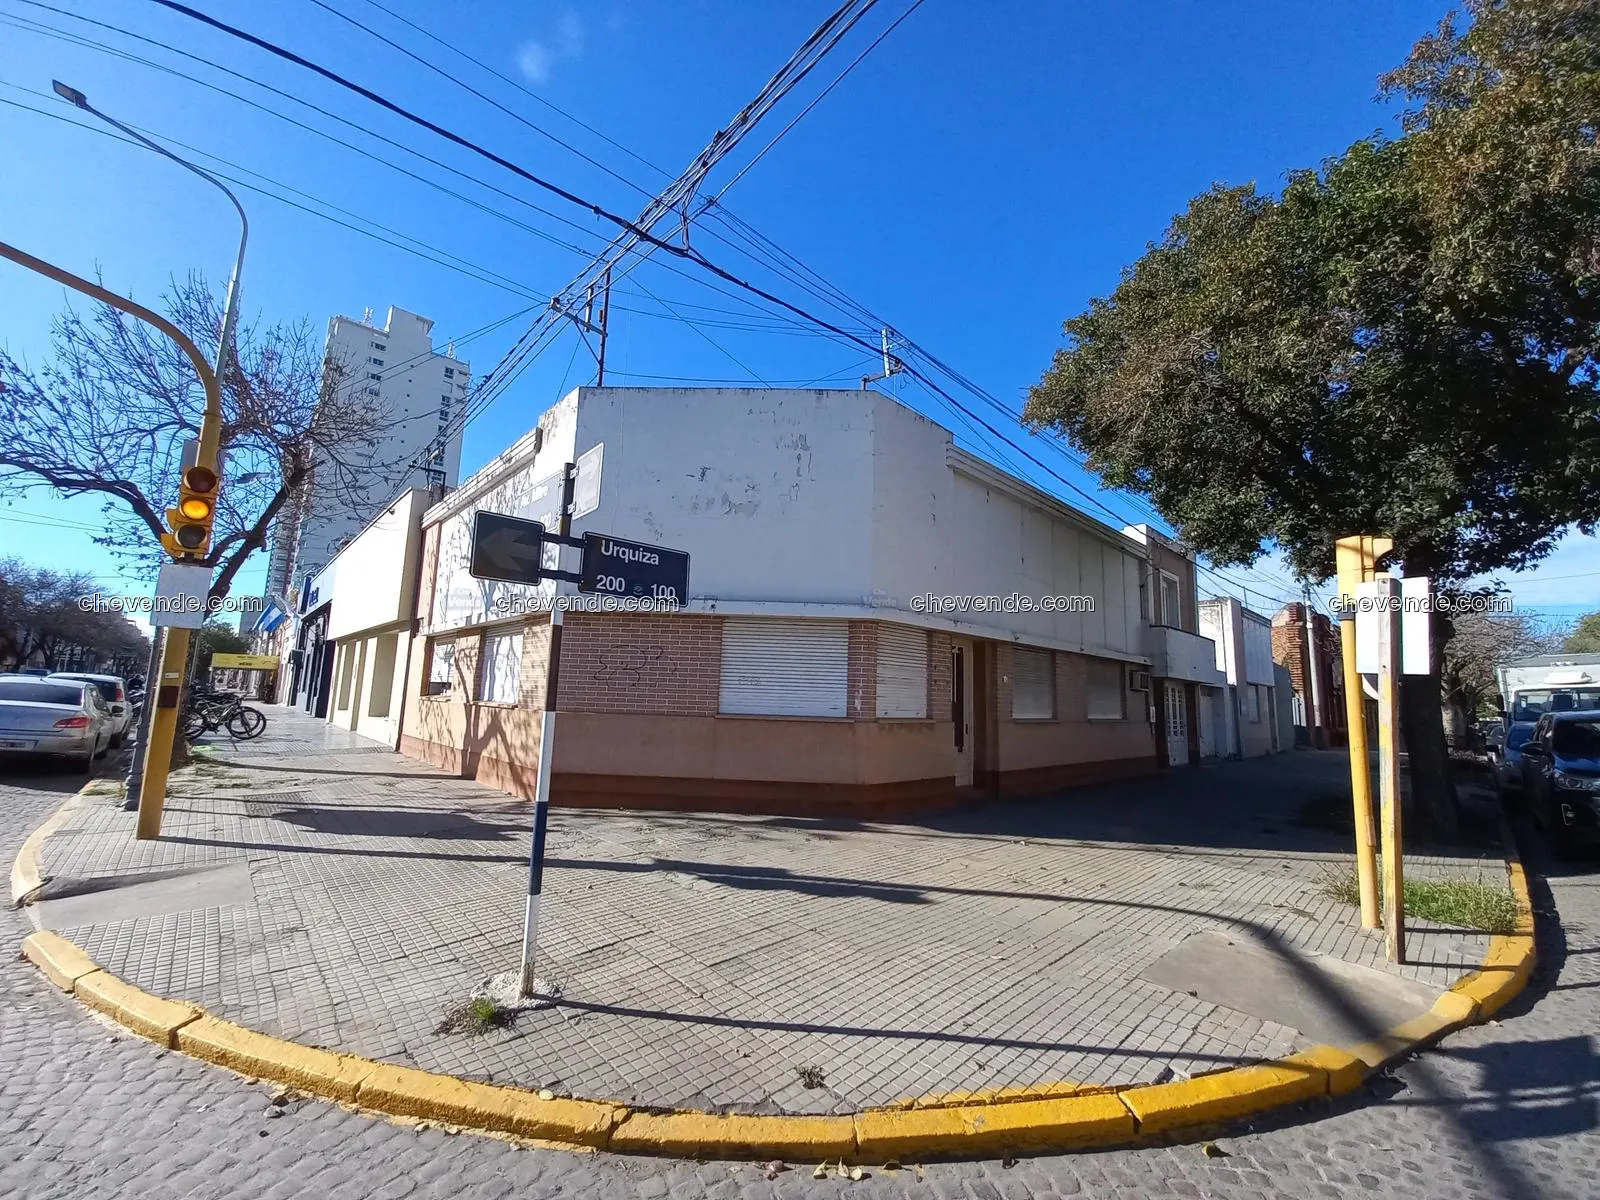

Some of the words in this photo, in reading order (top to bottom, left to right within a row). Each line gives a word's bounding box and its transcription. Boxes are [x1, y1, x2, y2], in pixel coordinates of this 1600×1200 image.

[600, 540, 660, 566] Urquiza
[595, 574, 626, 593] 200
[650, 583, 676, 600] 100
